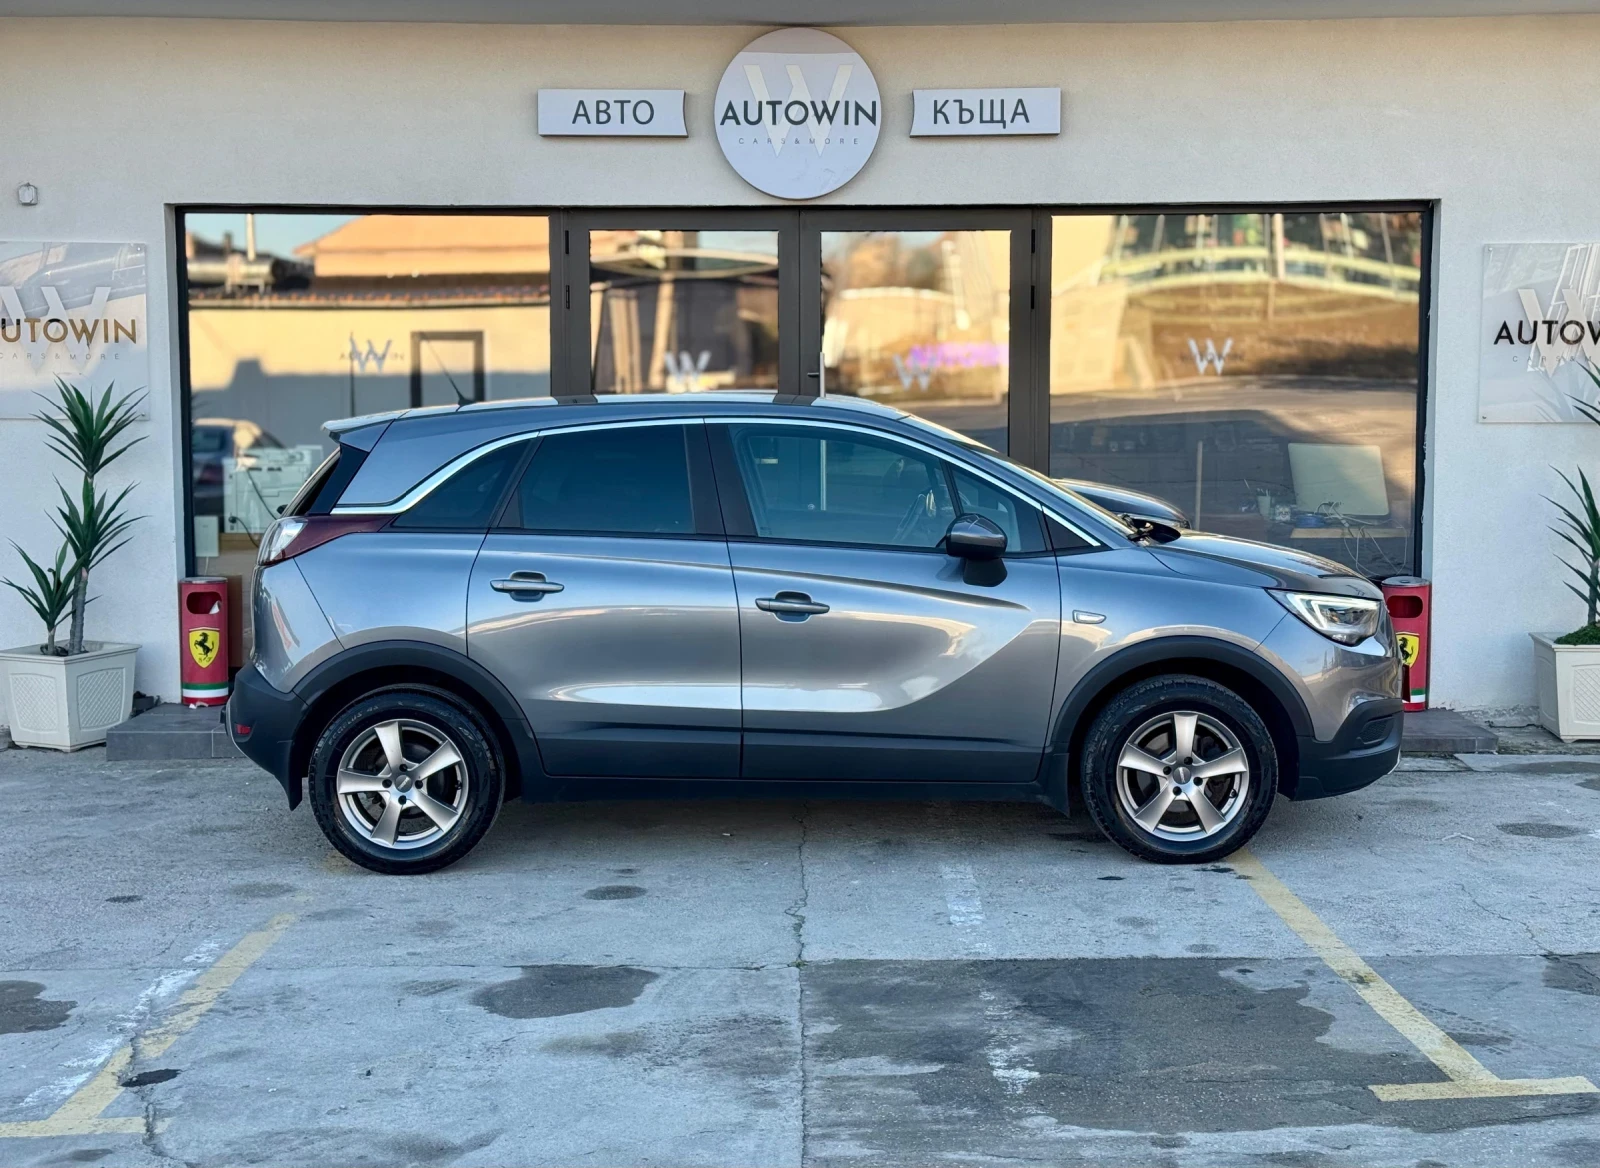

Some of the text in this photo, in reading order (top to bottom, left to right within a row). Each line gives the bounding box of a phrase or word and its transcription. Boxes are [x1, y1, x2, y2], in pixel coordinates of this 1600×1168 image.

[571, 98, 655, 126] АВТО
[720, 100, 877, 126] AUTOWIN
[932, 97, 1031, 129] КЪЩА
